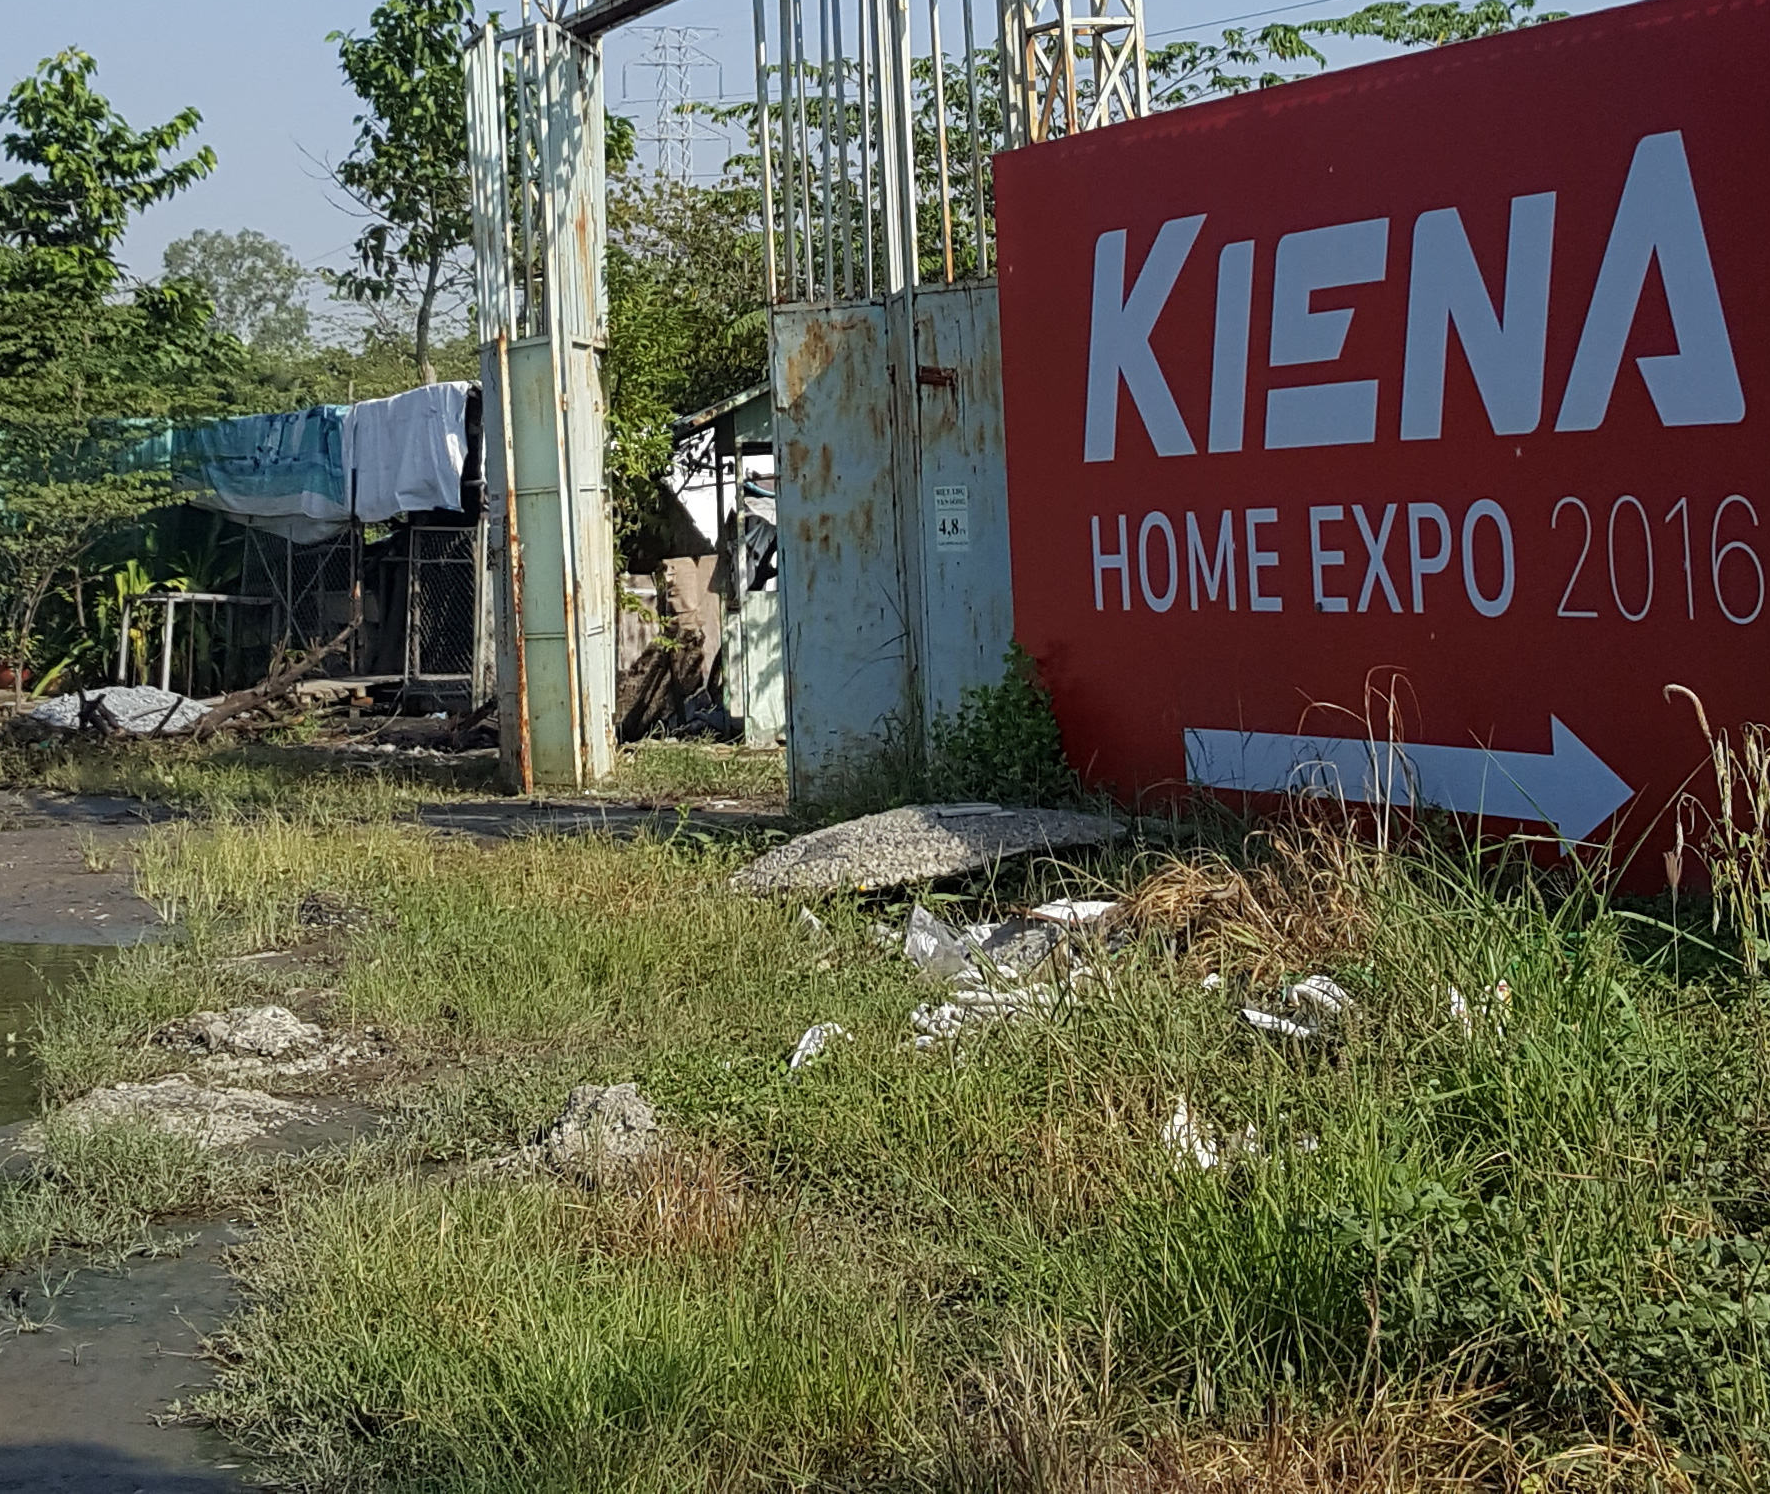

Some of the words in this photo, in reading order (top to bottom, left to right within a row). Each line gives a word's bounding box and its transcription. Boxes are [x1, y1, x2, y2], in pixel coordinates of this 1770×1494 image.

[1084, 130, 1745, 462] KIENA
[1091, 508, 1283, 612] HOME
[1309, 498, 1515, 618] EXPO
[1550, 495, 1766, 625] 2016
